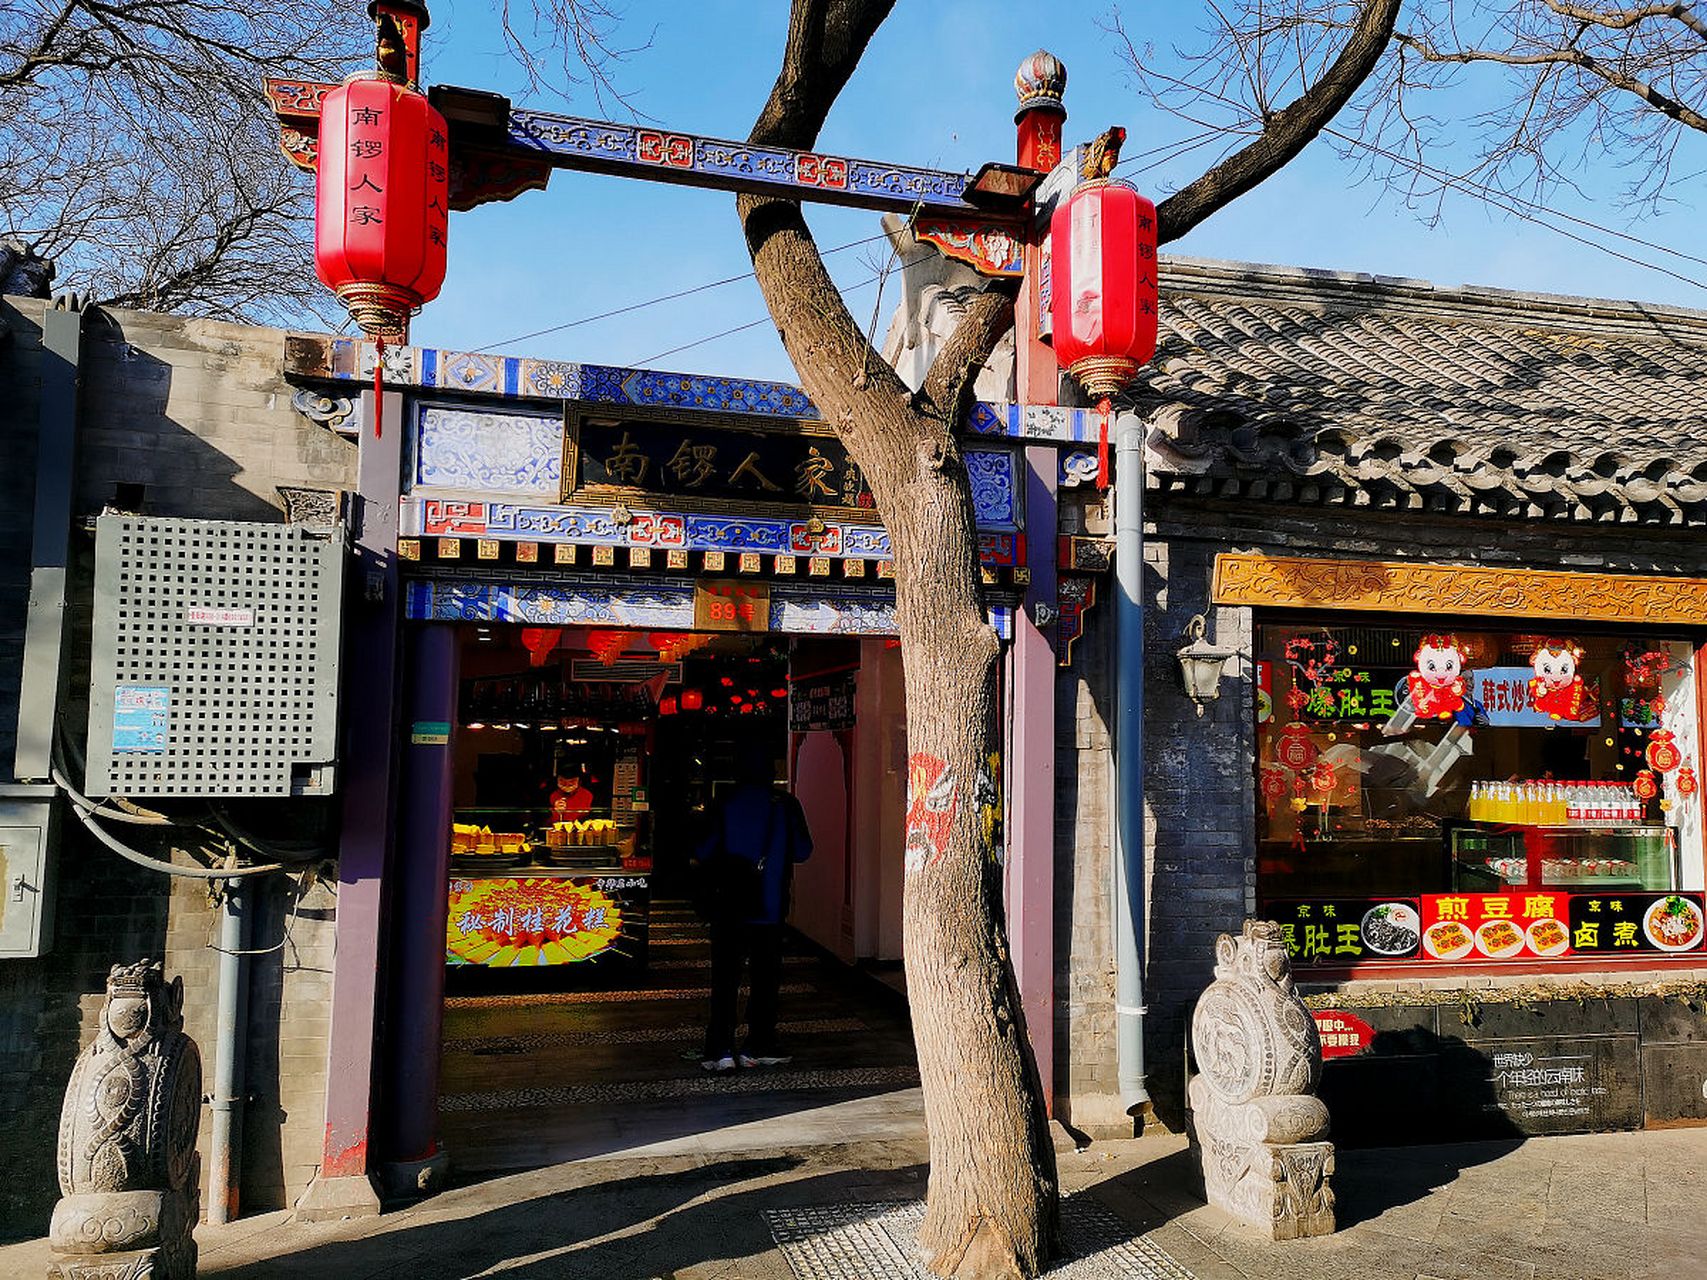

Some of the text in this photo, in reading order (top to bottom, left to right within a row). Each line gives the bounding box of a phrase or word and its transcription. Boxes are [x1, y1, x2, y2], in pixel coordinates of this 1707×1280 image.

[350, 106, 384, 226] 南锣人家
[604, 431, 839, 497] 南锣人家
[456, 905, 610, 936] 秘制桂花糕
[1297, 904, 1337, 918] 京味
[1435, 895, 1556, 921] 煎豆腐
[1588, 900, 1624, 913] 京味
[1574, 920, 1640, 948] 卤煮
